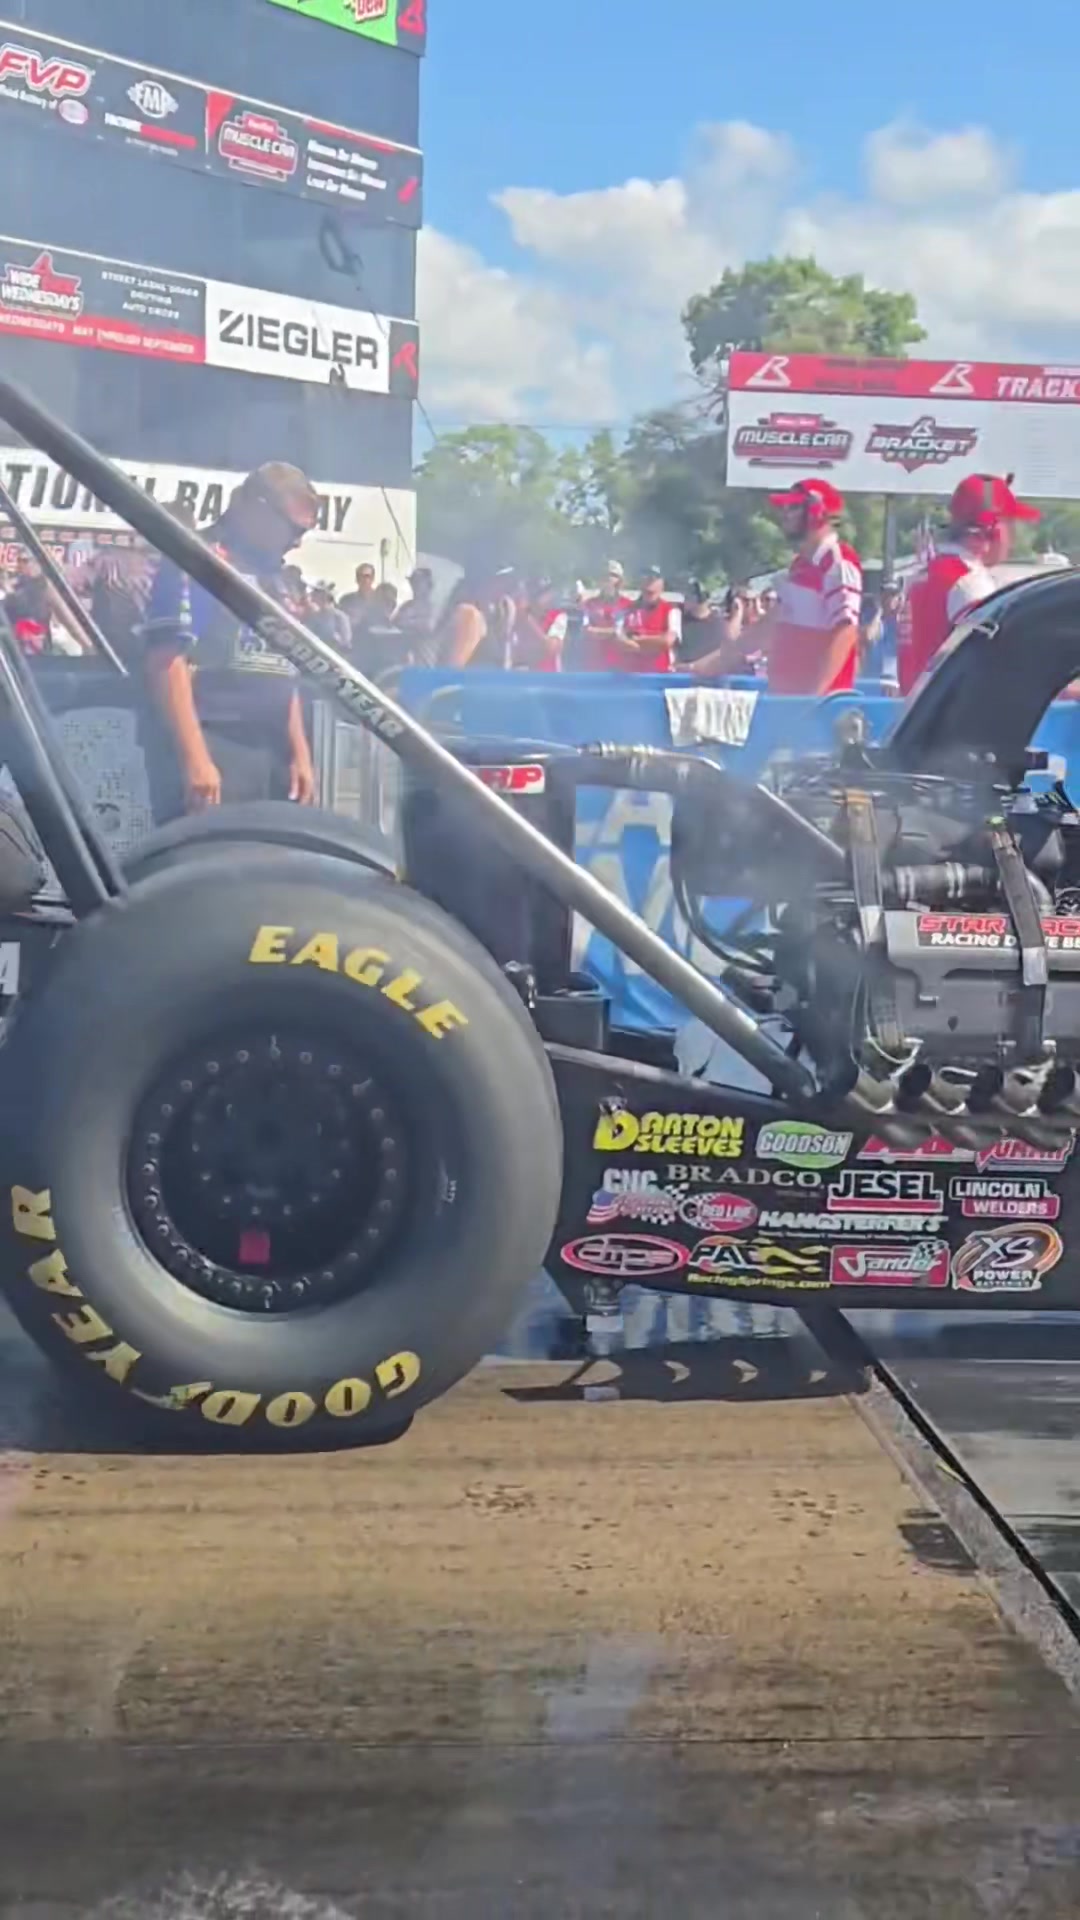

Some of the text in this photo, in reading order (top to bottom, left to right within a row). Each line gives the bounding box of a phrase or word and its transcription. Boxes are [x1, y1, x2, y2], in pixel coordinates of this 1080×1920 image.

[0, 49, 90, 91] FVP
[219, 309, 379, 369] ZIEGLER
[738, 430, 848, 446] MUSCLE CAR
[871, 436, 972, 452] BRACKET
[930, 933, 1000, 947] RACING
[249, 925, 469, 1040] EAGLE
[634, 1133, 743, 1157] SLEEVES
[760, 1132, 849, 1155] GOODSON
[832, 1172, 941, 1199] JESEL
[955, 1181, 1041, 1198] LINCOLN
[973, 1200, 1048, 1215] WELDERS
[973, 1270, 1033, 1281] POWER
